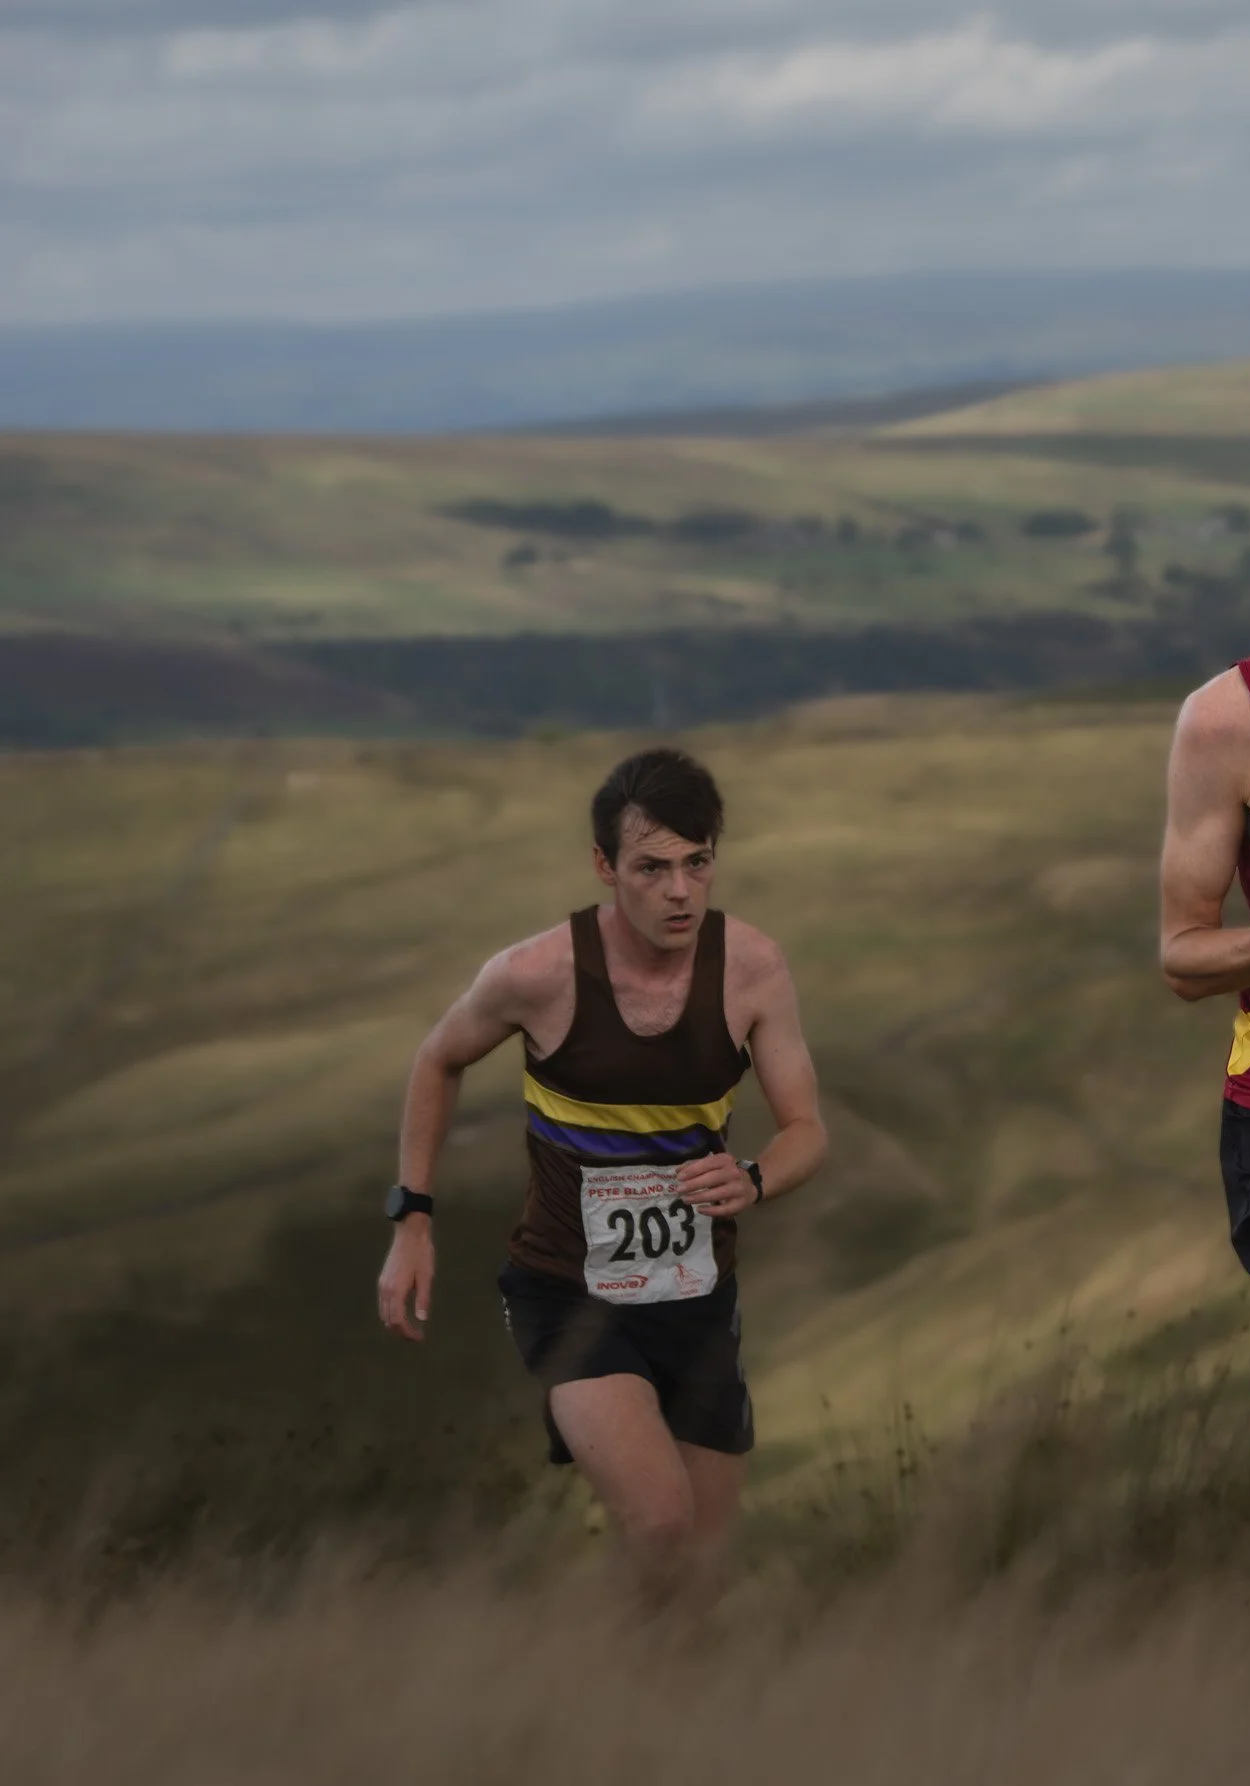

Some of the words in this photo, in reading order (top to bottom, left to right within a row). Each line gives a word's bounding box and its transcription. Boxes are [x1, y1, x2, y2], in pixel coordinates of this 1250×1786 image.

[588, 1174, 625, 1183] ENGLISH
[588, 1187, 619, 1198] PETE
[624, 1184, 664, 1195] BLAND
[608, 1199, 695, 1262] 203
